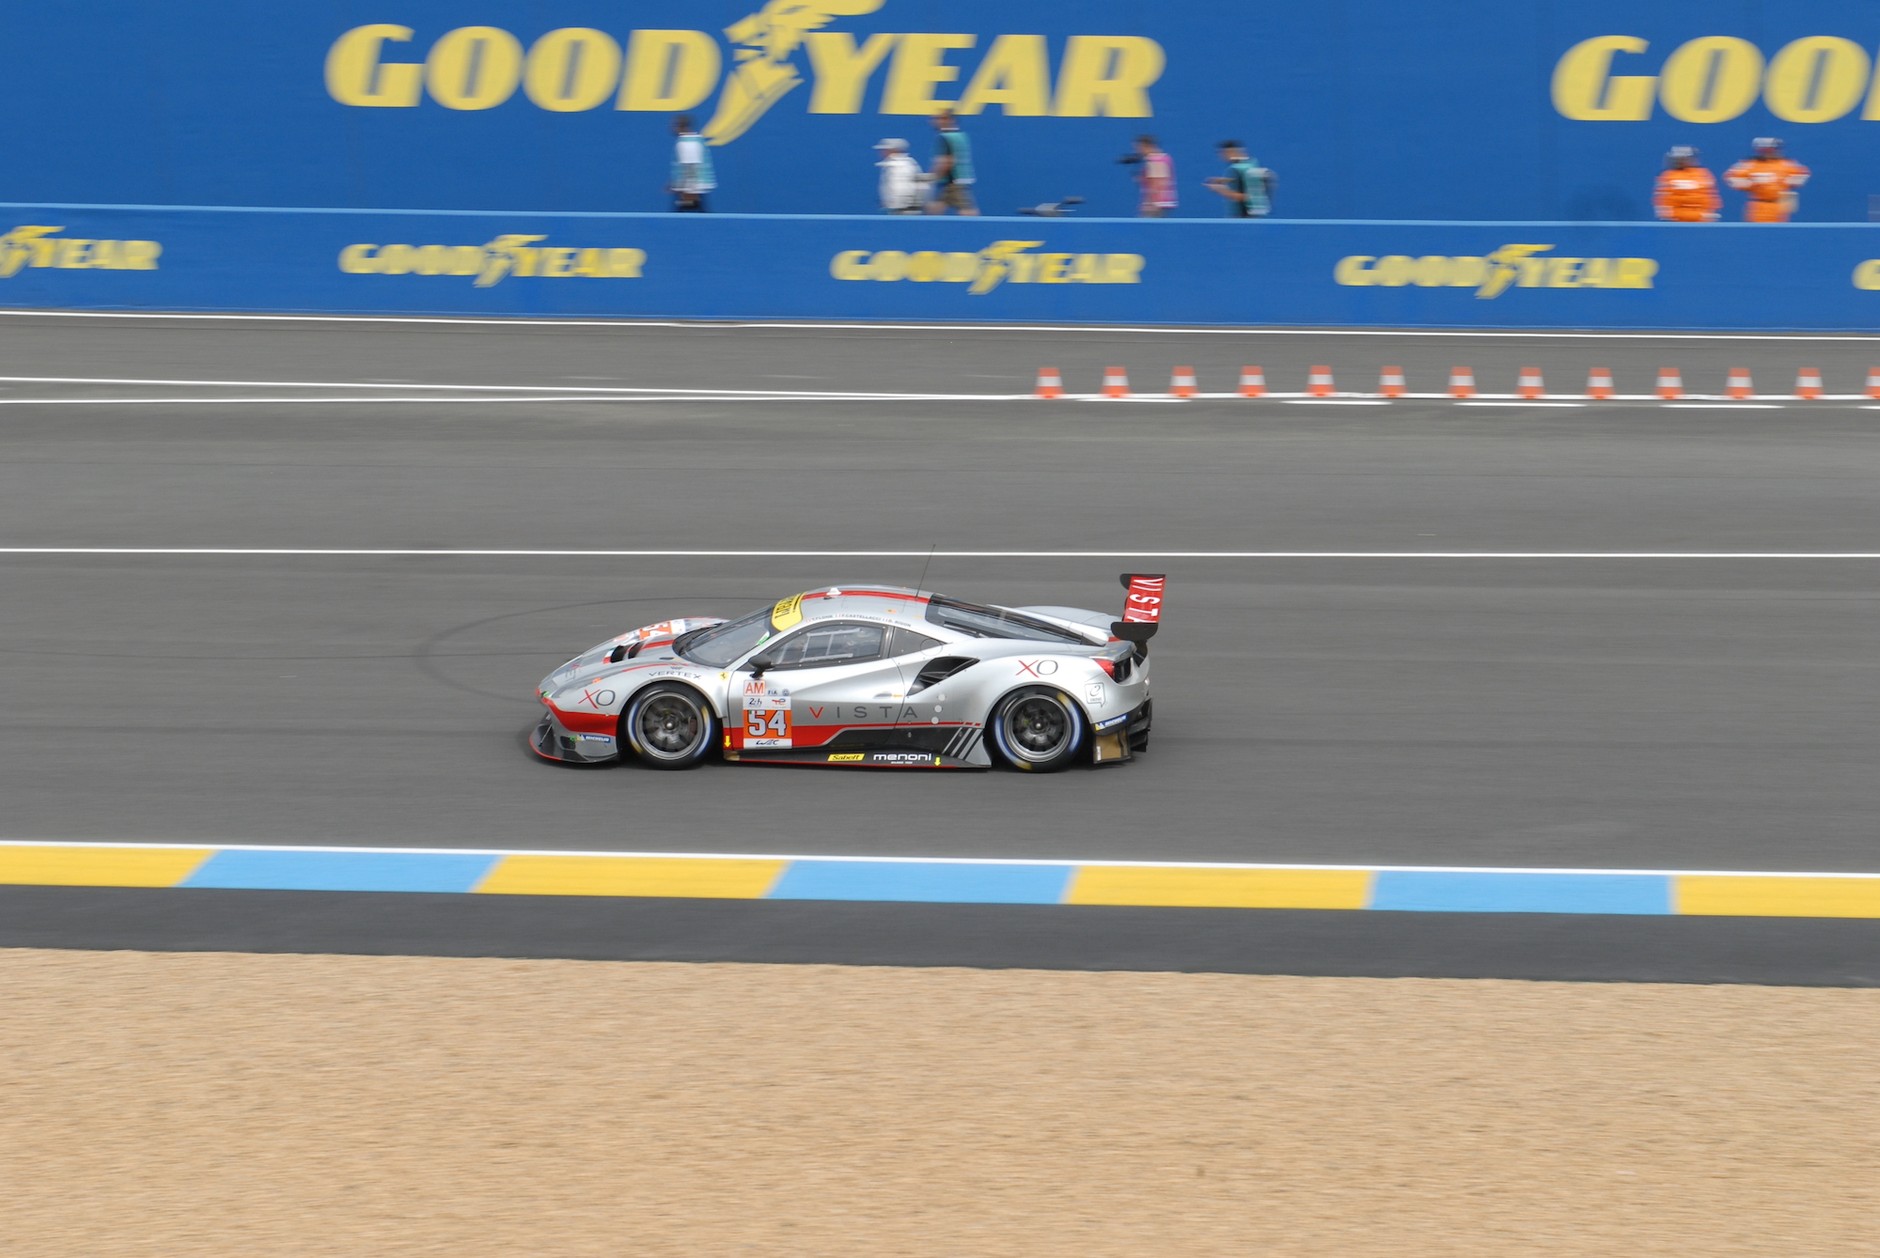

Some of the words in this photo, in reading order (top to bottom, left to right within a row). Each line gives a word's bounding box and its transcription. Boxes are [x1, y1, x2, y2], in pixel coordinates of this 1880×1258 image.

[1552, 35, 1880, 123] GOO
[339, 240, 646, 280] GOODYEAR
[831, 246, 1145, 286] GOODYEAR
[1335, 251, 1659, 292] GOODYEAR
[648, 671, 702, 679] VERTEX
[1015, 659, 1059, 679] XO
[578, 689, 616, 709] XO
[745, 682, 764, 694] AM
[747, 710, 787, 737] 54
[809, 706, 918, 719] VISTA
